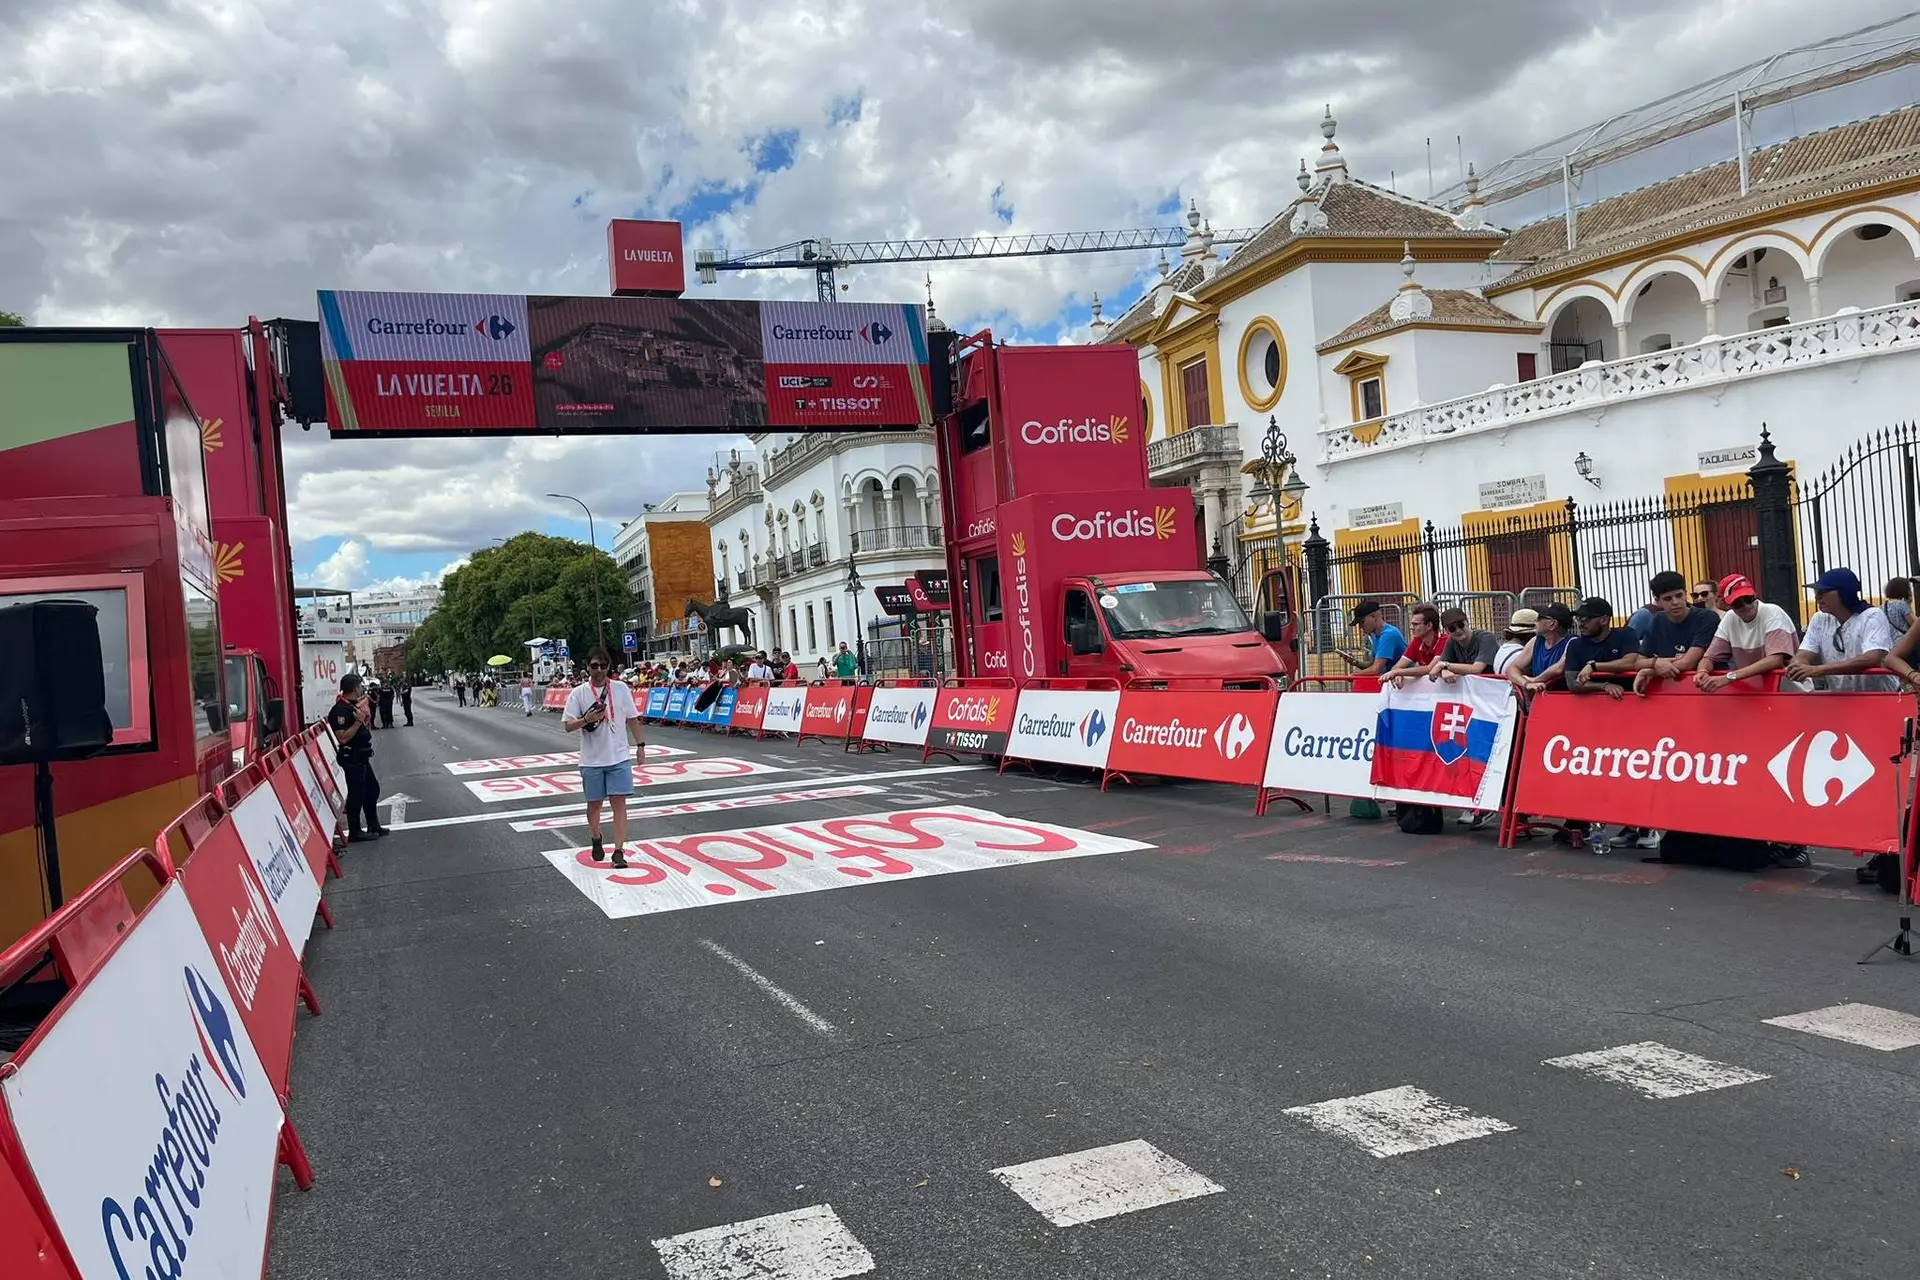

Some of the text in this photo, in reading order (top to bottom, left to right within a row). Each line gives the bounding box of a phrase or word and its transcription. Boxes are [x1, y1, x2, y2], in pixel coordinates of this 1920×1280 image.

[624, 249, 674, 263] LA VUELTA
[368, 318, 468, 335] Carrefour
[773, 325, 853, 341] Carrefour
[376, 373, 513, 396] LA VUELTA 26
[781, 378, 799, 386] UCI
[425, 405, 460, 418] SEVILLA
[820, 398, 881, 410] TISSOT
[1021, 417, 1111, 445] Cofidis
[1698, 450, 1756, 466] TAQUILLAS
[1497, 478, 1526, 488] SOMBRA
[968, 519, 996, 538] Cofidis
[1051, 508, 1156, 541] Cofidis
[1017, 557, 1035, 677] Cofidis
[984, 651, 1008, 669] Cofid
[313, 655, 337, 685] rtve
[806, 702, 834, 718] Carrefour
[871, 705, 909, 724] Carrefour
[947, 696, 989, 722] Cofidis
[1018, 713, 1075, 738] Carrefour
[1122, 718, 1208, 748] Carrefour
[956, 732, 988, 749] TISSOT
[1284, 726, 1377, 762] Carrefo
[1543, 734, 1748, 786] Carrefour
[574, 811, 1078, 896] Cofidis
[219, 907, 267, 1011] Carrefour
